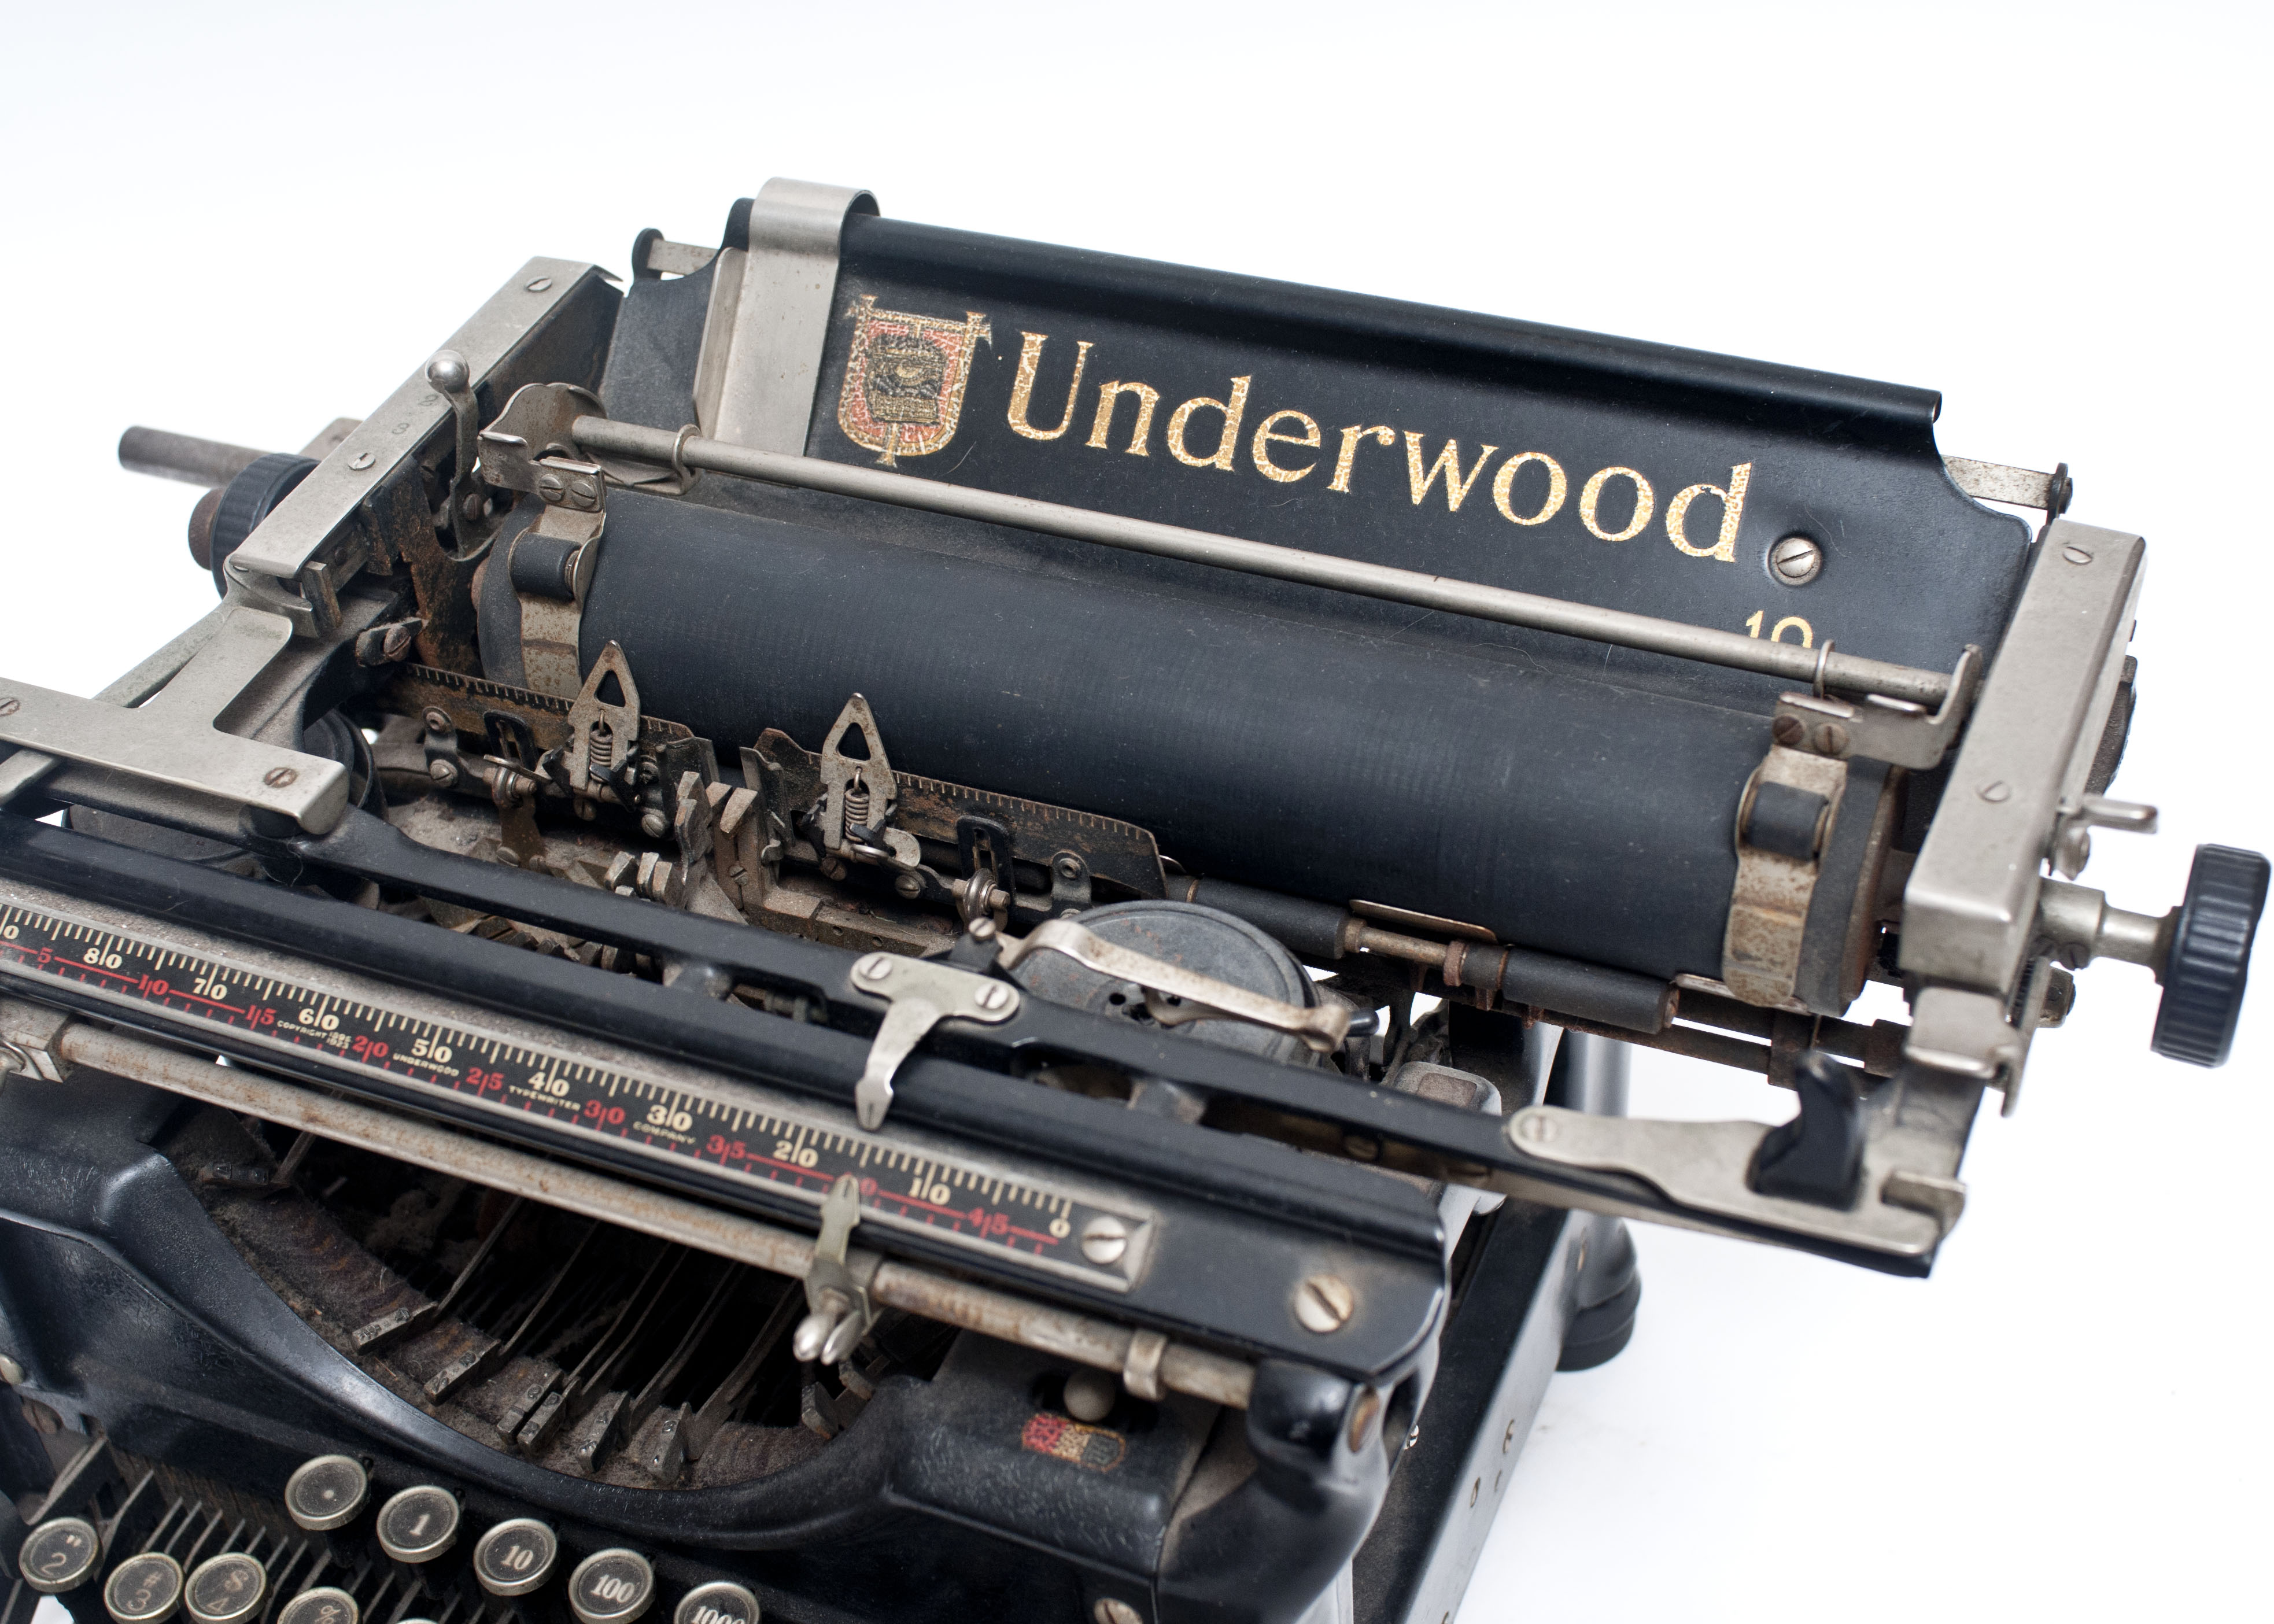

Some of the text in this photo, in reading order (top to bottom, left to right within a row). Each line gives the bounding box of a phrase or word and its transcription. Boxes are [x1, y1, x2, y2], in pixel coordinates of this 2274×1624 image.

[1007, 331, 1752, 562] Underwood
[37, 947, 53, 964] 5
[276, 1020, 328, 1039] COPYRIGHT
[83, 947, 122, 969] 80
[193, 978, 228, 1000] 70
[298, 1008, 339, 1031] 60
[411, 1038, 452, 1063] 50
[528, 1072, 570, 1097] 40
[647, 1105, 693, 1132] 30
[773, 1140, 818, 1168] 20
[1049, 1218, 1070, 1238] 0
[392, 1053, 696, 1145] UNDERWOOD TYPEWRITER COMPANY
[409, 1514, 430, 1537] 1
[40, 1552, 67, 1577] 2
[501, 1545, 534, 1570] 10
[127, 1589, 151, 1611] 3
[590, 1574, 636, 1604] 100
[205, 1597, 230, 1613] 4
